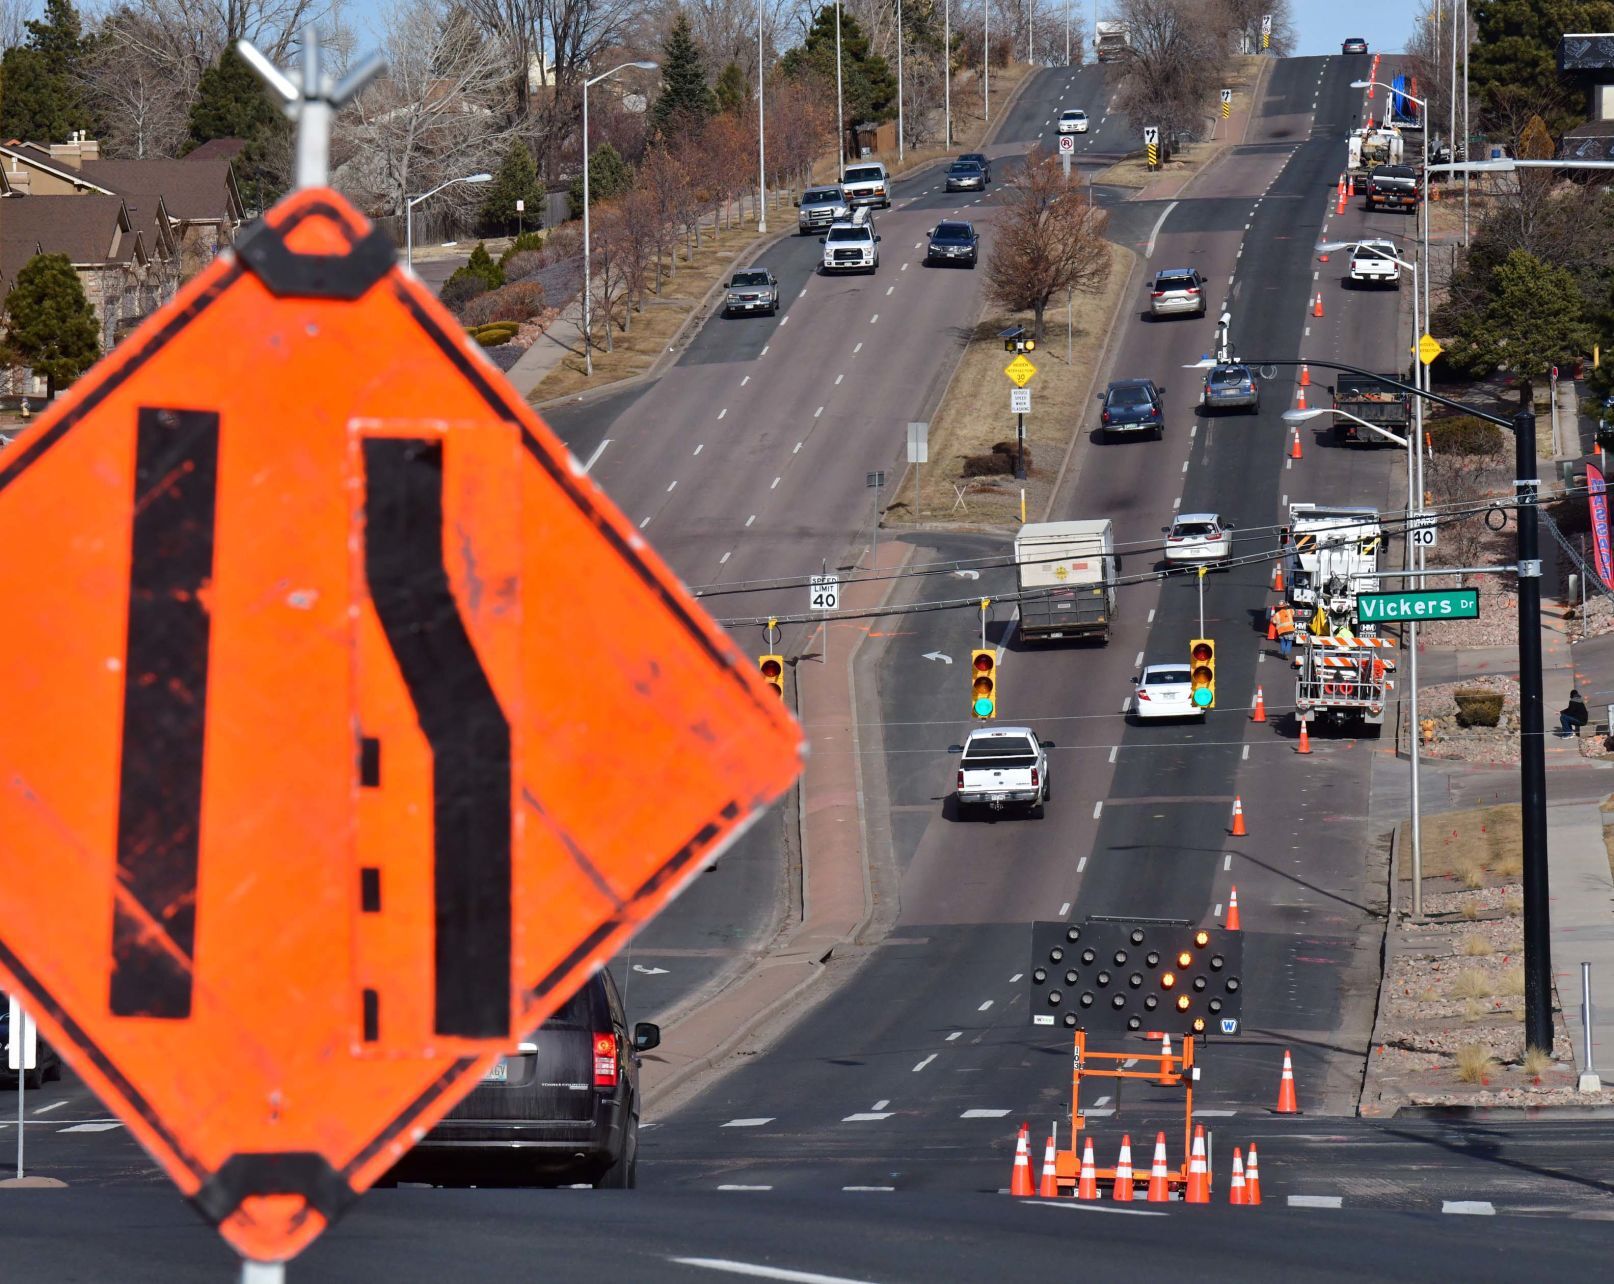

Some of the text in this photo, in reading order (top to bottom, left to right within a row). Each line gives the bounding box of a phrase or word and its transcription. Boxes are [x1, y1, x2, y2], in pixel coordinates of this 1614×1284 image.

[1414, 530, 1433, 544] 40
[812, 577, 837, 585] SPEED
[812, 593, 836, 607] 40
[1361, 598, 1474, 617] Vickers Dr
[1223, 1021, 1235, 1032] W
